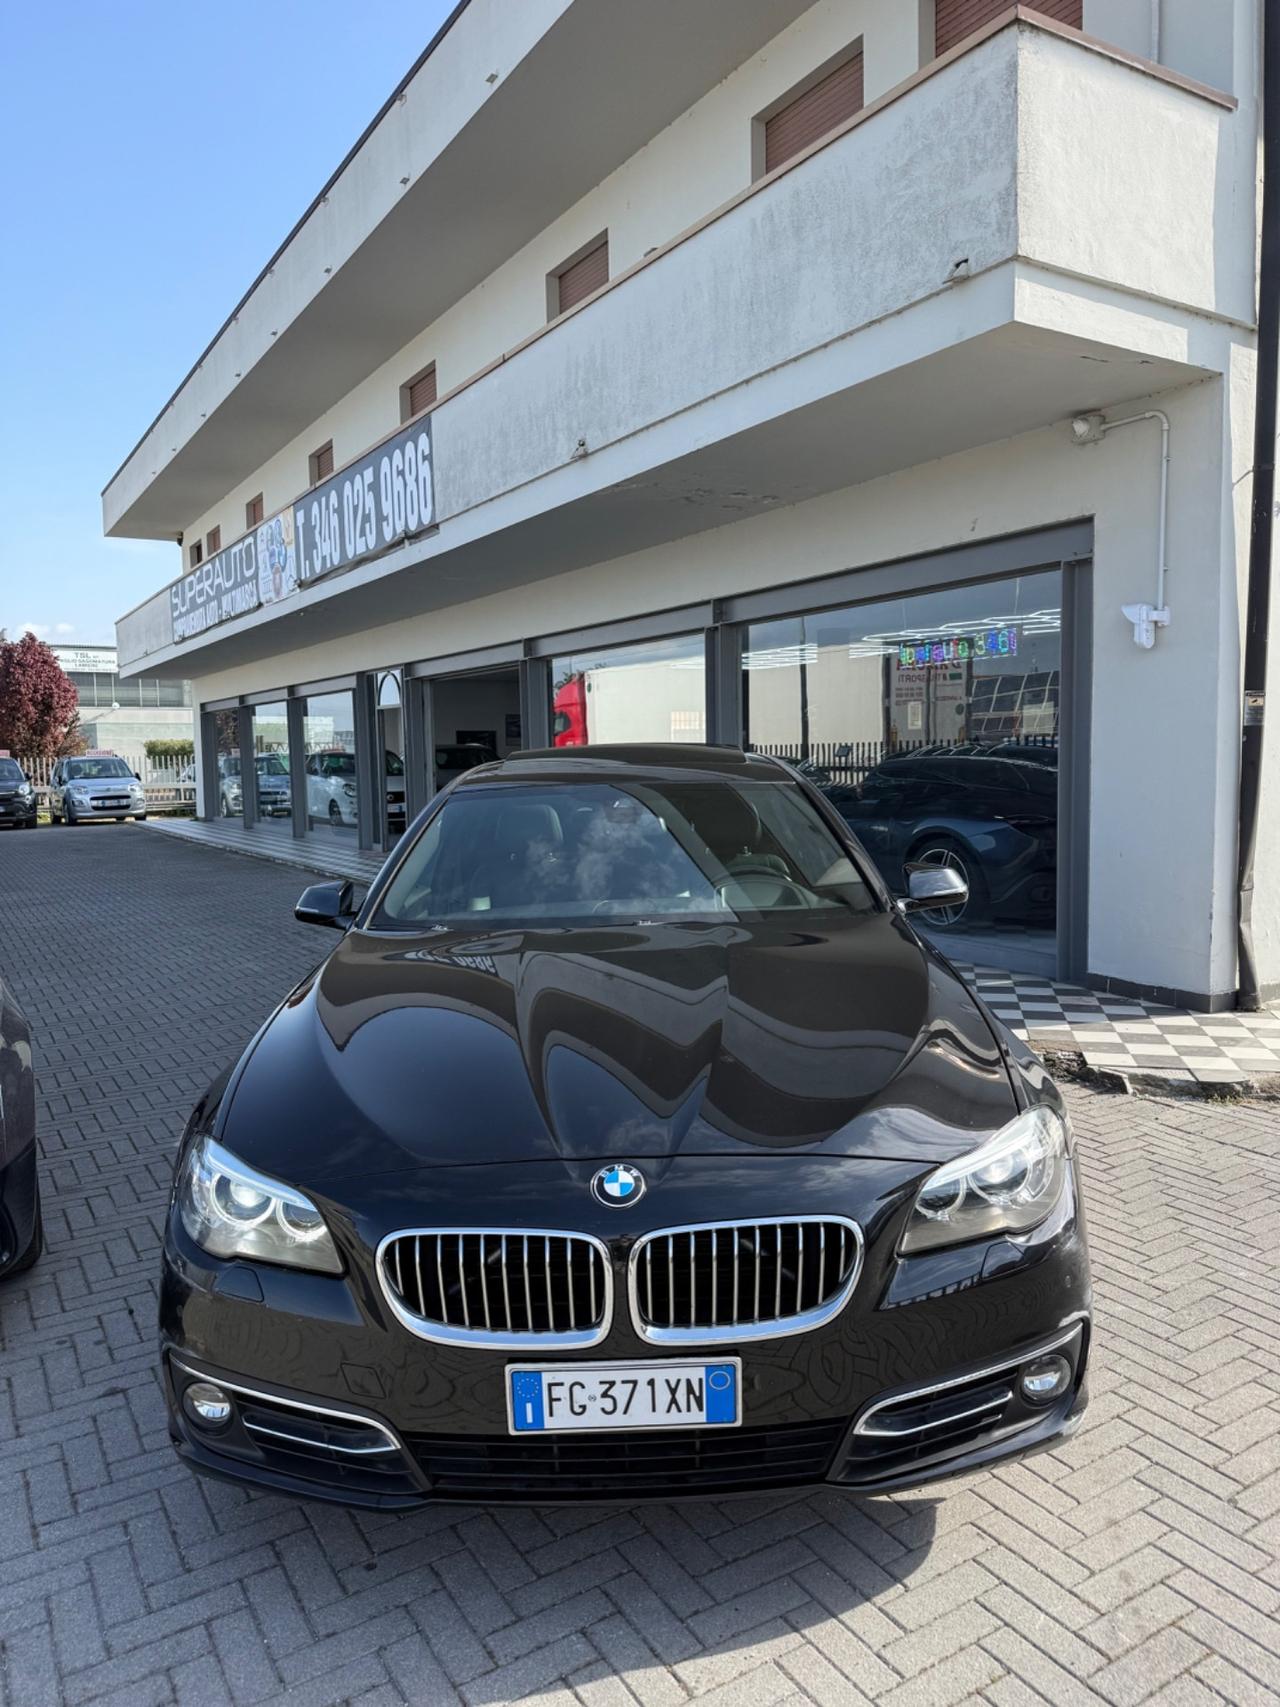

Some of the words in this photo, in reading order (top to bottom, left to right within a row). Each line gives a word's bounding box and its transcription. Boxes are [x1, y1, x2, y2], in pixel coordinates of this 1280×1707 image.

[296, 509, 310, 580] T.
[311, 489, 341, 574] 346
[343, 466, 376, 560] 025
[380, 432, 433, 542] 9686
[171, 536, 256, 618] SUPERAUTO
